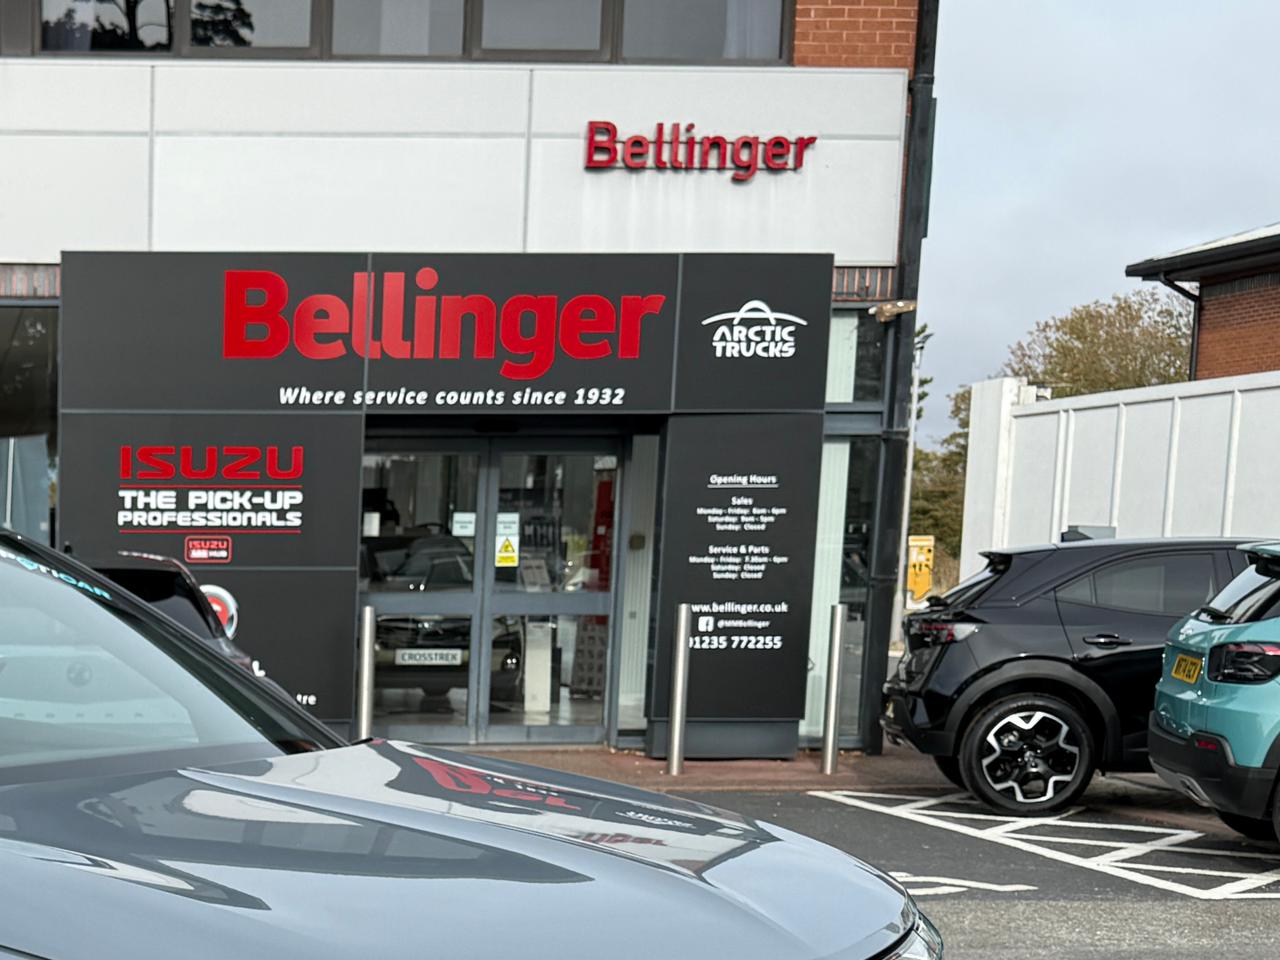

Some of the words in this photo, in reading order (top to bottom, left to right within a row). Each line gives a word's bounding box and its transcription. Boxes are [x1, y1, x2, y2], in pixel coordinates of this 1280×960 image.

[584, 120, 818, 182] Bellinger
[222, 267, 667, 381] Bellinger
[712, 325, 796, 342] ARCTIC
[712, 341, 796, 358] TRUCKS
[278, 387, 346, 405] Where
[352, 387, 427, 405] service
[435, 388, 506, 405] counts
[511, 388, 568, 405] since
[574, 388, 626, 405] 1932
[120, 445, 304, 480] ISUZU
[709, 474, 748, 486] Opening
[749, 475, 777, 484] Hours
[118, 490, 177, 509] THE
[187, 490, 304, 510] PICK-UP
[731, 496, 753, 506] Sales
[696, 507, 723, 516] Monday
[117, 510, 303, 527] PROFESSIONALS
[743, 523, 766, 531] Closed
[188, 540, 228, 549] ISUZU
[708, 545, 738, 555] Service
[739, 545, 747, 554] &
[748, 545, 770, 555] Parts
[688, 556, 715, 564] Monday
[743, 563, 766, 572] Closed
[740, 571, 763, 579] Closed
[691, 601, 788, 614] ww.bellinger.co.uk
[730, 635, 783, 649] 772255
[400, 651, 458, 662] CROSSTREK
